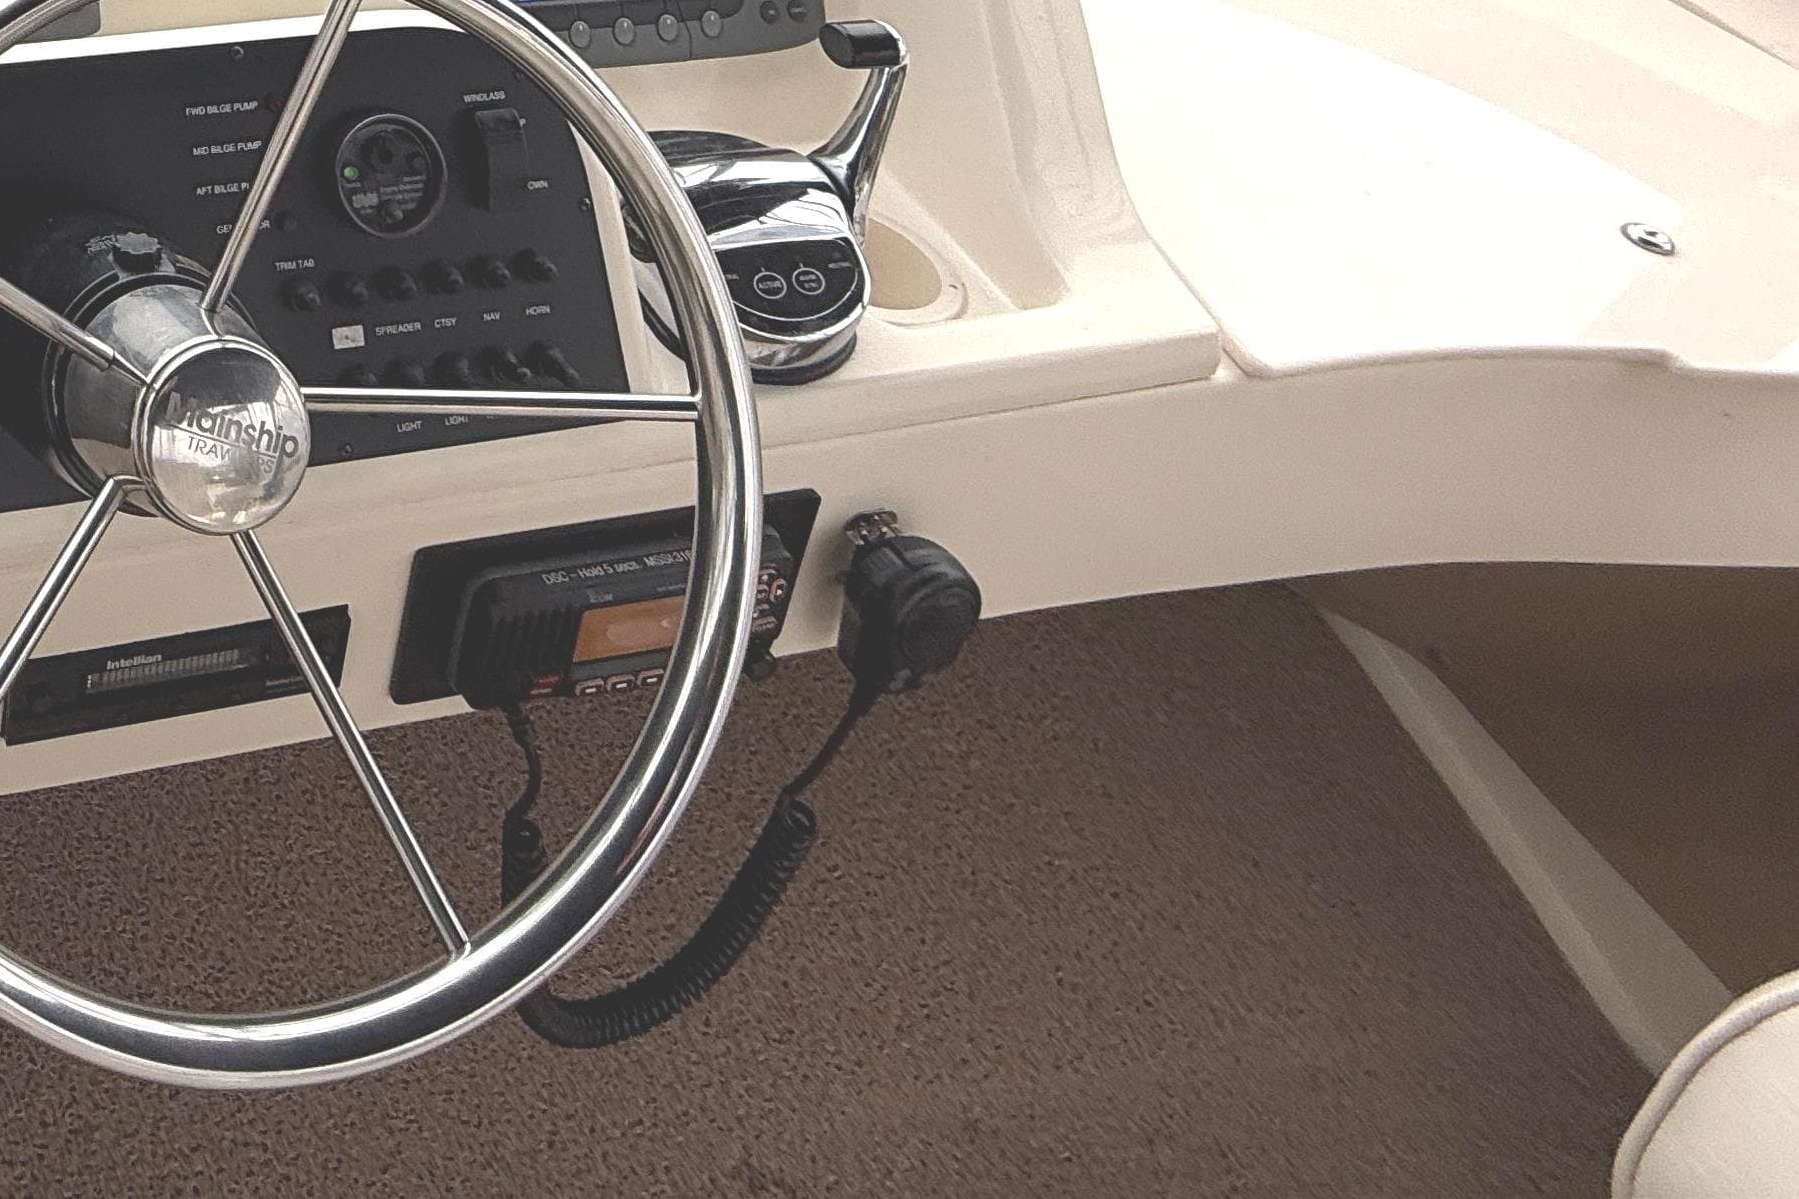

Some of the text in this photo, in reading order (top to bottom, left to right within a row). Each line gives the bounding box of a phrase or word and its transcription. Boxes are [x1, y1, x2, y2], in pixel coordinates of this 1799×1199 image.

[463, 90, 506, 103] WINDLASS
[185, 101, 258, 116] FWD BILGE PUMP
[211, 143, 236, 154] BILGE
[238, 140, 262, 151] PUMP
[196, 185, 212, 196] AFT
[214, 183, 239, 194] BILGE
[527, 180, 549, 189] OWN
[274, 258, 315, 271] TRIM TAB
[483, 311, 501, 321] NAV
[526, 305, 550, 316] HORN
[375, 321, 422, 336] SPREADER
[434, 317, 457, 328] CTSY
[166, 391, 299, 466] Mainship
[397, 420, 422, 433] LIGHT
[542, 570, 569, 585] DSC
[578, 565, 602, 580] Hold
[603, 562, 613, 575] 5
[107, 653, 162, 670] Intellian
